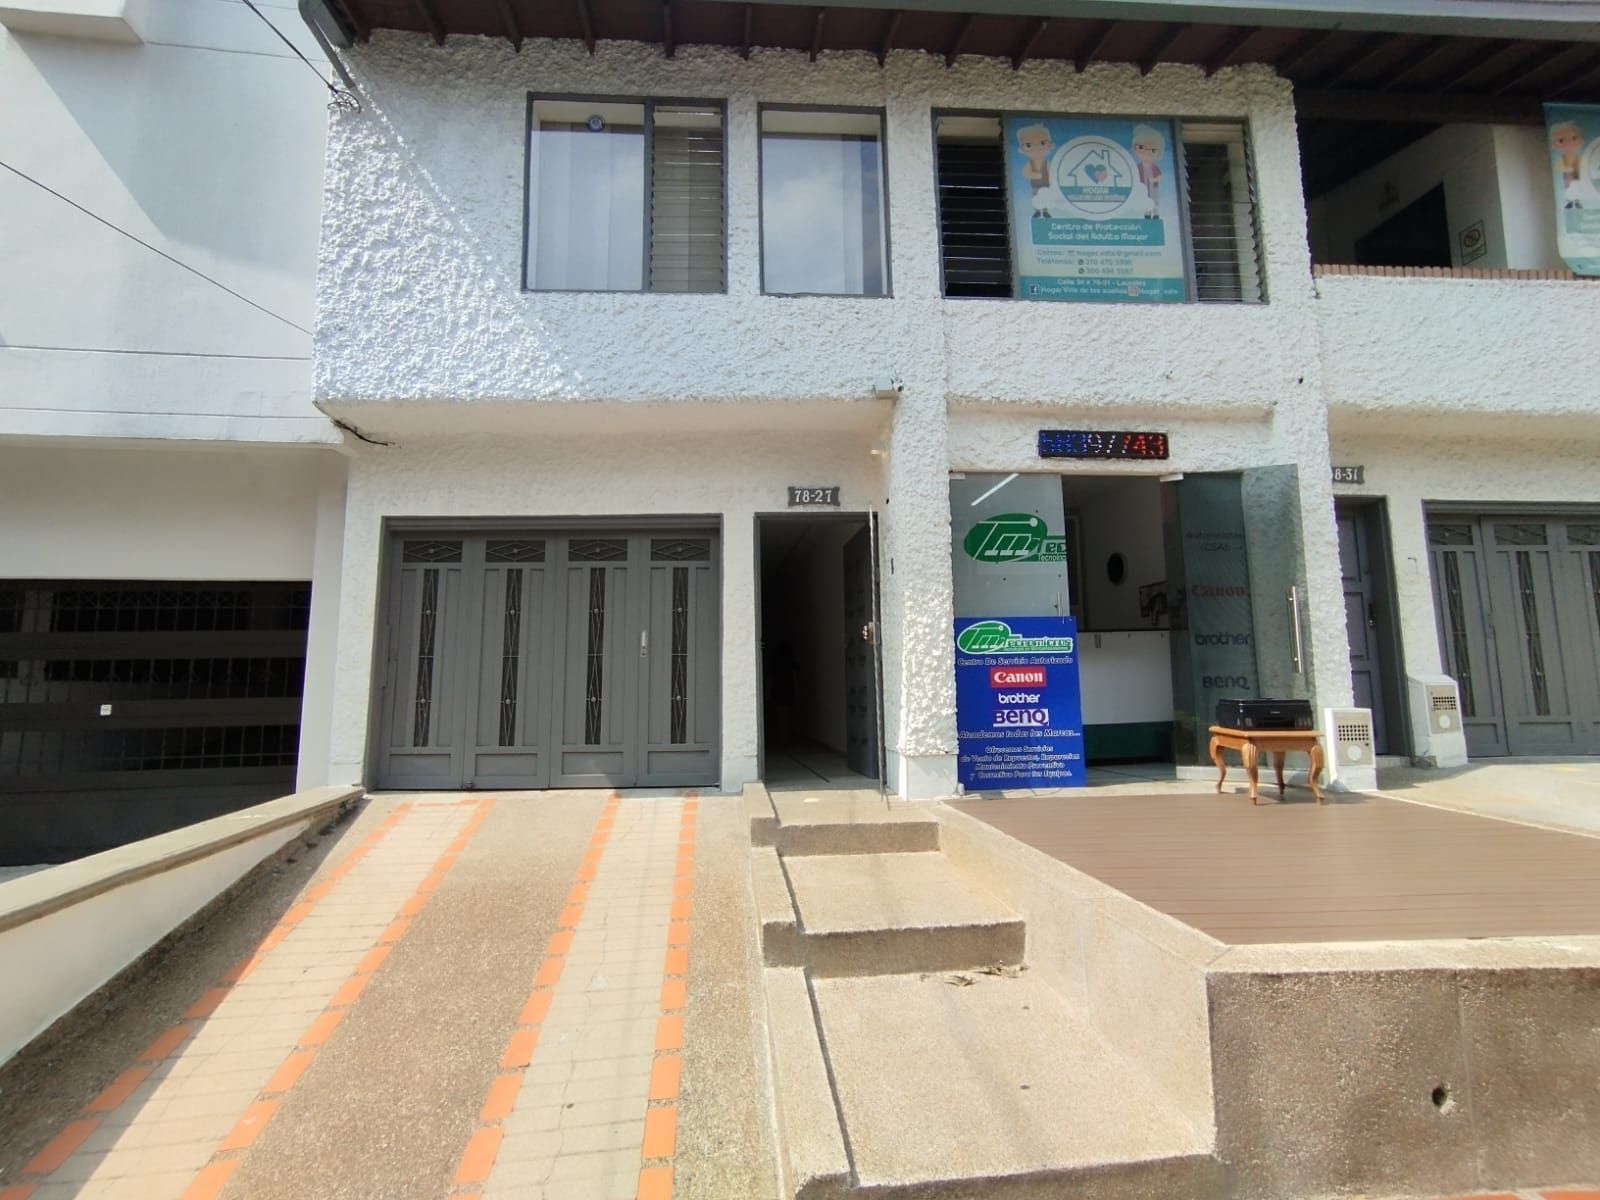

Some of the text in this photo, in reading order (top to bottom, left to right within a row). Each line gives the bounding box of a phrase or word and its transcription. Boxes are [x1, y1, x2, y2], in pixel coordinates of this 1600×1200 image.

[1051, 223, 1080, 231] Centro
[1082, 223, 1093, 231] de
[1048, 232, 1073, 240] Social
[1075, 232, 1089, 240] del
[1121, 233, 1148, 241] Mayor
[794, 489, 833, 503] 78-27
[1191, 583, 1247, 598] Canon
[1194, 631, 1250, 646] brother
[994, 671, 1043, 683] Canon
[998, 693, 1040, 704] brother
